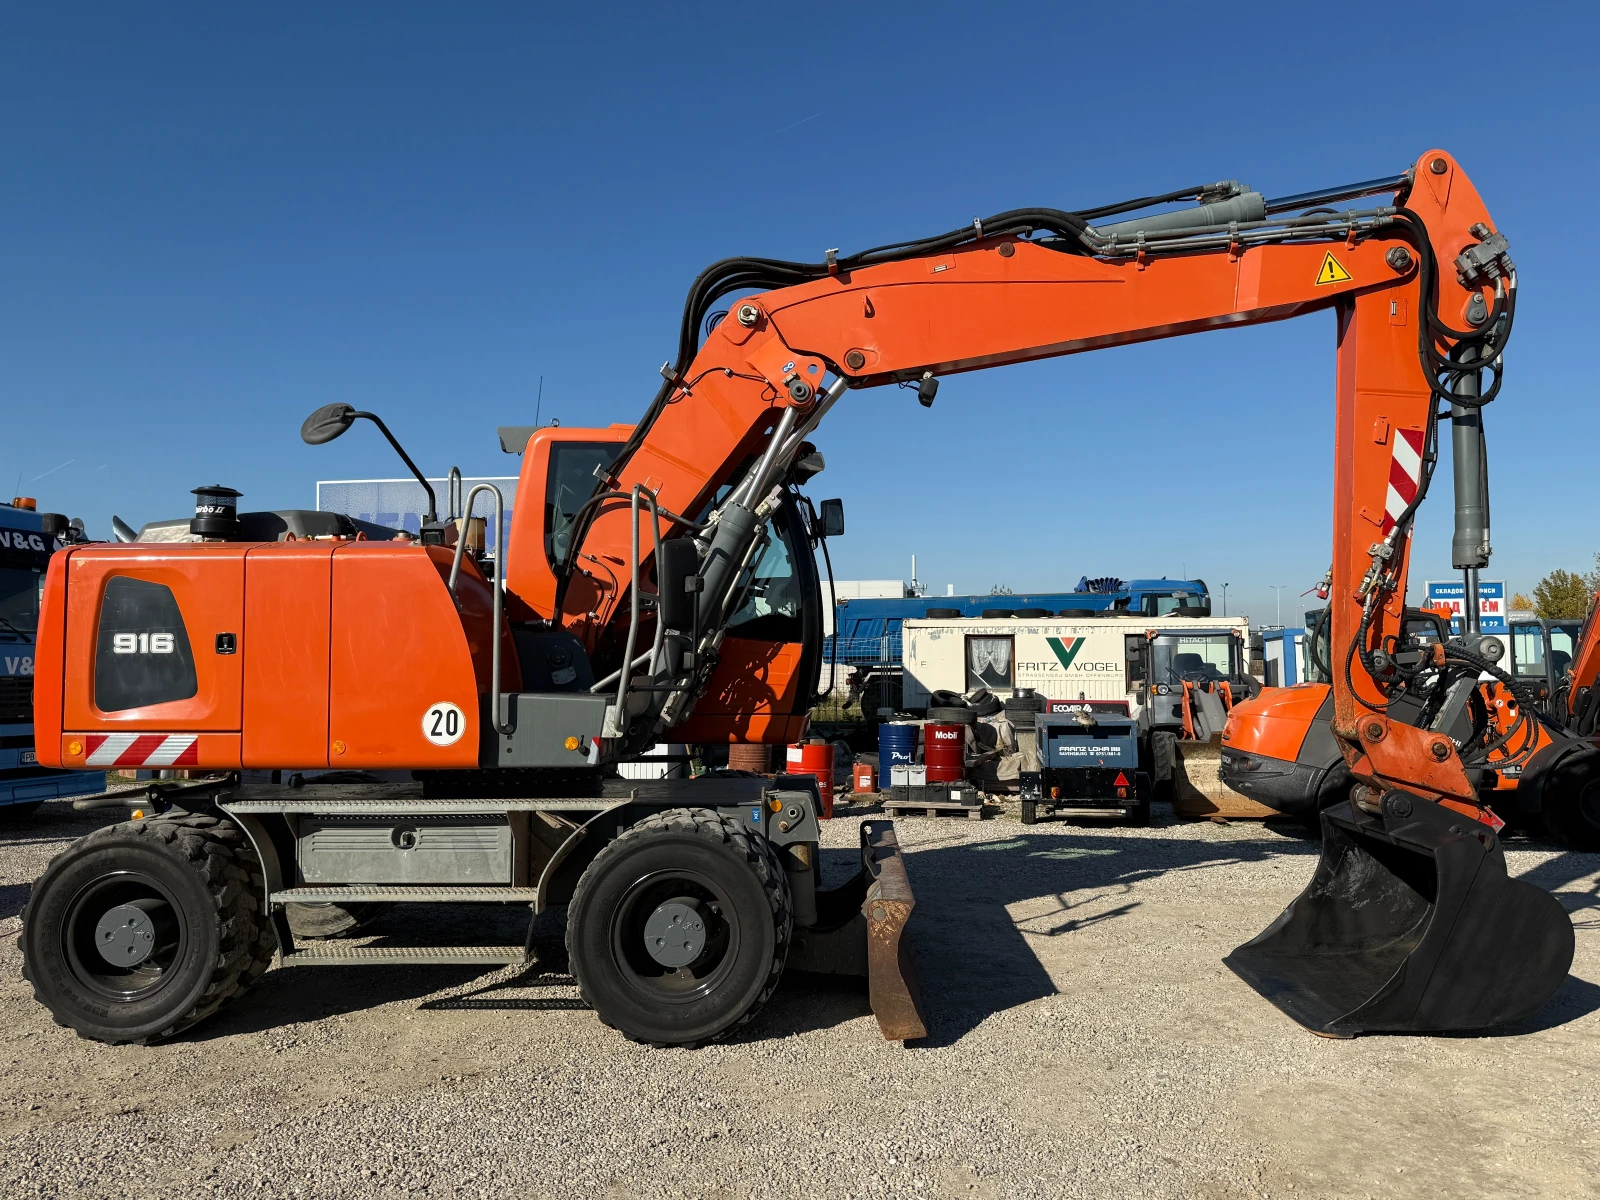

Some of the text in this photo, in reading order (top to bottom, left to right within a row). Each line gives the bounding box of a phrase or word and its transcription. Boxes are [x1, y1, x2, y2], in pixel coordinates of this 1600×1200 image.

[1481, 601, 1499, 613] ЕМ
[113, 632, 175, 654] 916
[4, 656, 34, 675] V&
[1017, 662, 1124, 672] FRITZ VOGEL
[1052, 704, 1082, 713] ECOAIR
[430, 709, 459, 737] 20
[935, 731, 958, 739] Mobil
